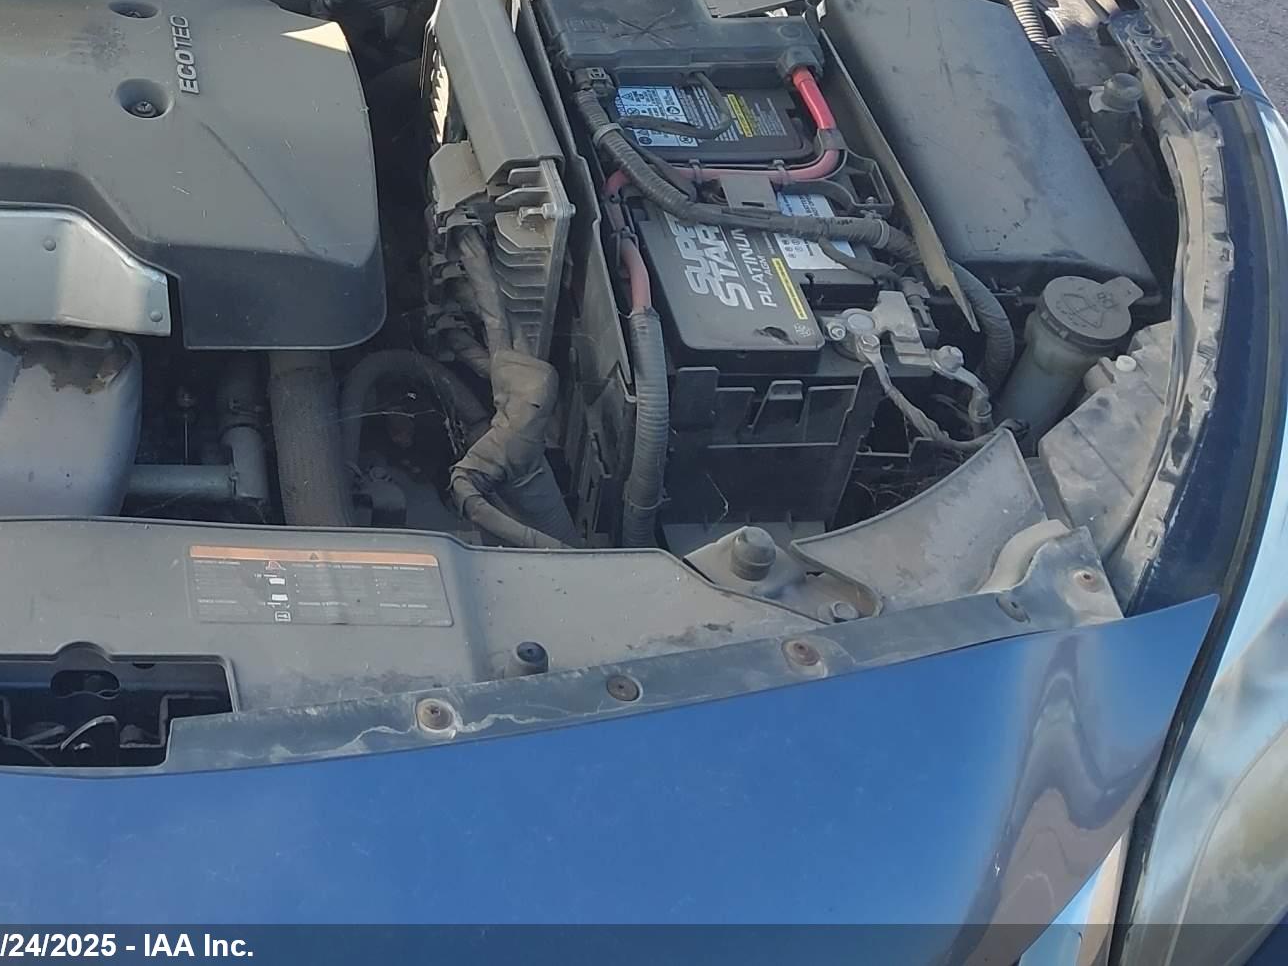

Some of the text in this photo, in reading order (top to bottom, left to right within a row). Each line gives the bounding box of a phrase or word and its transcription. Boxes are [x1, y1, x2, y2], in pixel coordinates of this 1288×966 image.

[170, 15, 199, 94] ECOTEC
[664, 211, 711, 295] SUPE
[694, 224, 754, 310] STAR
